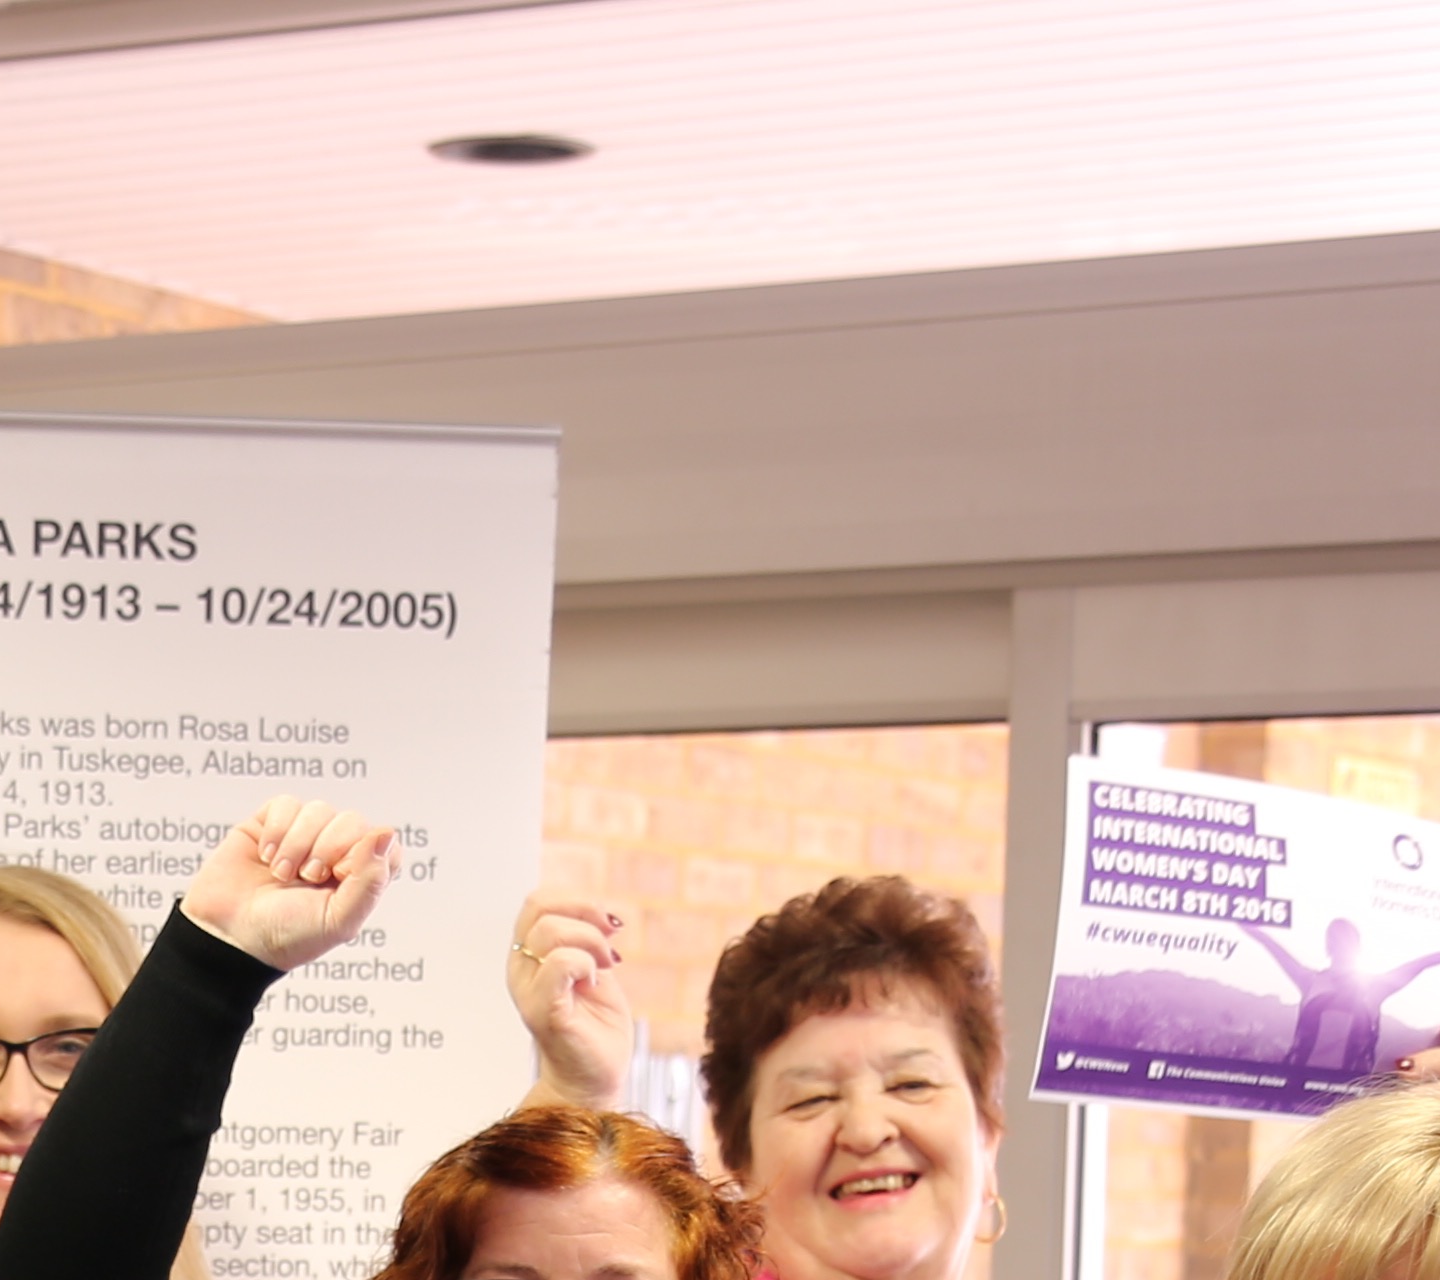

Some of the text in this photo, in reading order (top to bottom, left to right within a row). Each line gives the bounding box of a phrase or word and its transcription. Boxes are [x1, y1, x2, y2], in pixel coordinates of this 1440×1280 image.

[33, 520, 199, 561] PARKS
[196, 588, 458, 638] 10/24/2005)
[40, 718, 95, 738] was
[106, 713, 168, 739] born
[179, 716, 248, 742] Rosa
[258, 718, 350, 744] Louise
[20, 748, 42, 771] in
[52, 749, 192, 779] Tuskegee,
[202, 752, 322, 778] Alabama
[333, 757, 367, 779] on
[3, 780, 28, 807] 4,
[39, 782, 114, 806] 1913.
[1093, 785, 1249, 826] CELEBRATING
[1093, 815, 1283, 862] INTERNATIONAL
[52, 851, 95, 873] her
[105, 850, 203, 876] earliest
[412, 856, 437, 881] of
[1211, 862, 1261, 889] DAY
[1089, 880, 1288, 923] MARCH 8TH 2016
[1087, 923, 1239, 960] #cwuequality
[305, 959, 423, 982] marched
[285, 989, 375, 1017] house,
[273, 1025, 443, 1054] guarding the
[353, 1122, 403, 1146] Fair
[206, 1157, 370, 1179] boarded the
[246, 1189, 386, 1214] 1, 1955, in
[257, 1225, 345, 1245] seat in
[212, 1258, 317, 1280] section,
